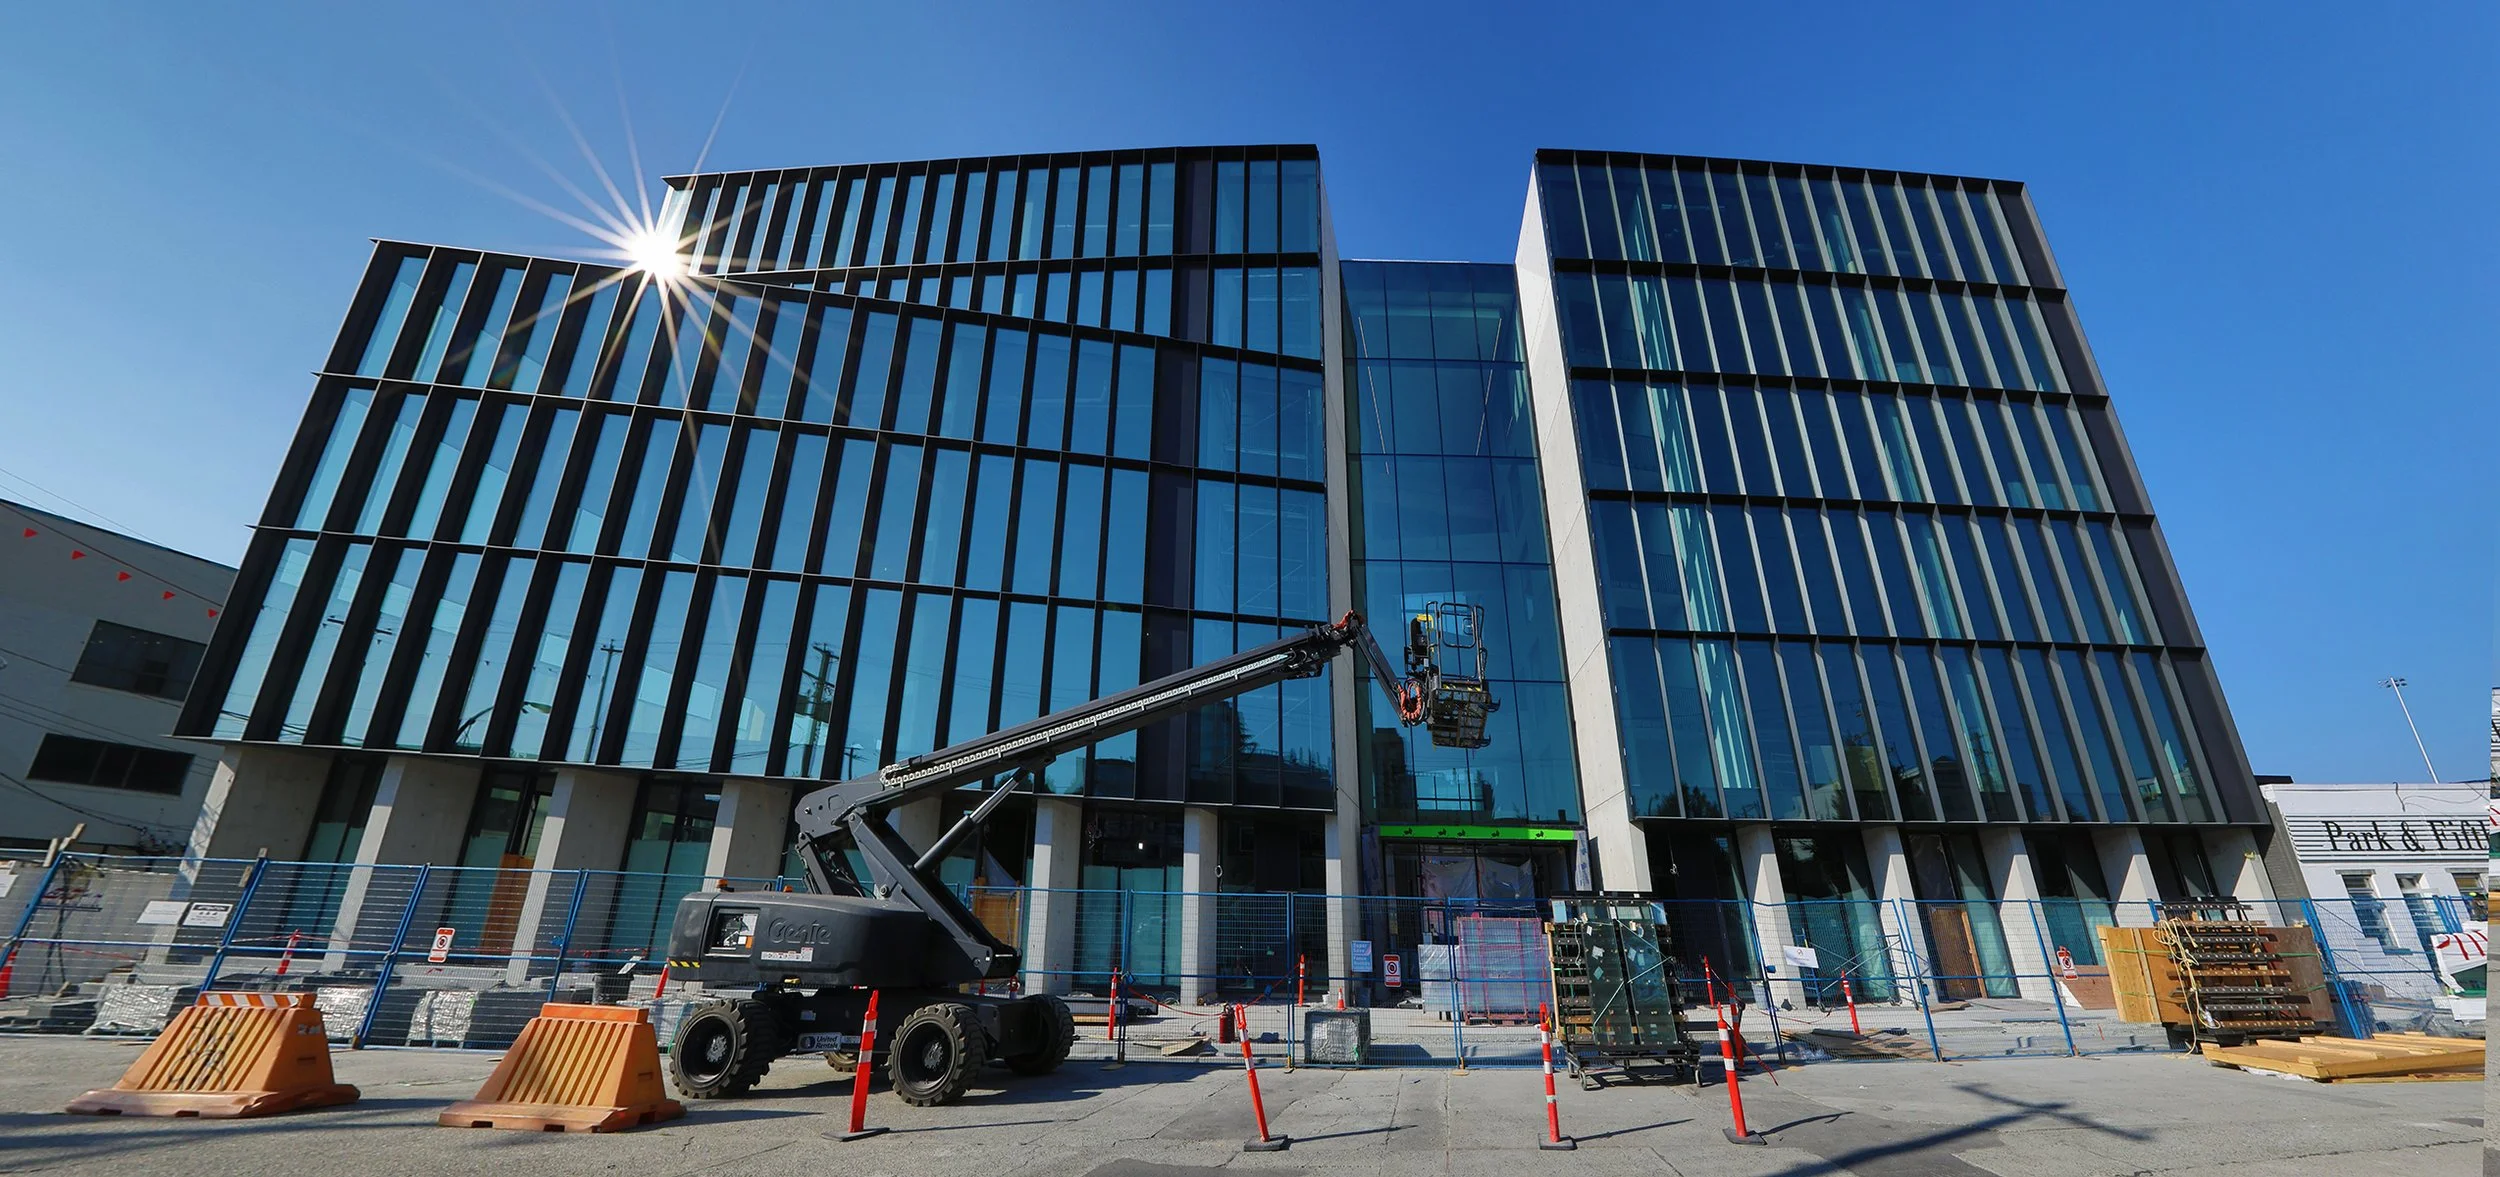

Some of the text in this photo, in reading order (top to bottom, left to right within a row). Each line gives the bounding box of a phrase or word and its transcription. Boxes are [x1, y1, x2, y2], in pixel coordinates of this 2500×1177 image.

[2321, 820, 2395, 851] Park
[2400, 820, 2426, 852] &
[768, 917, 831, 945] Genie
